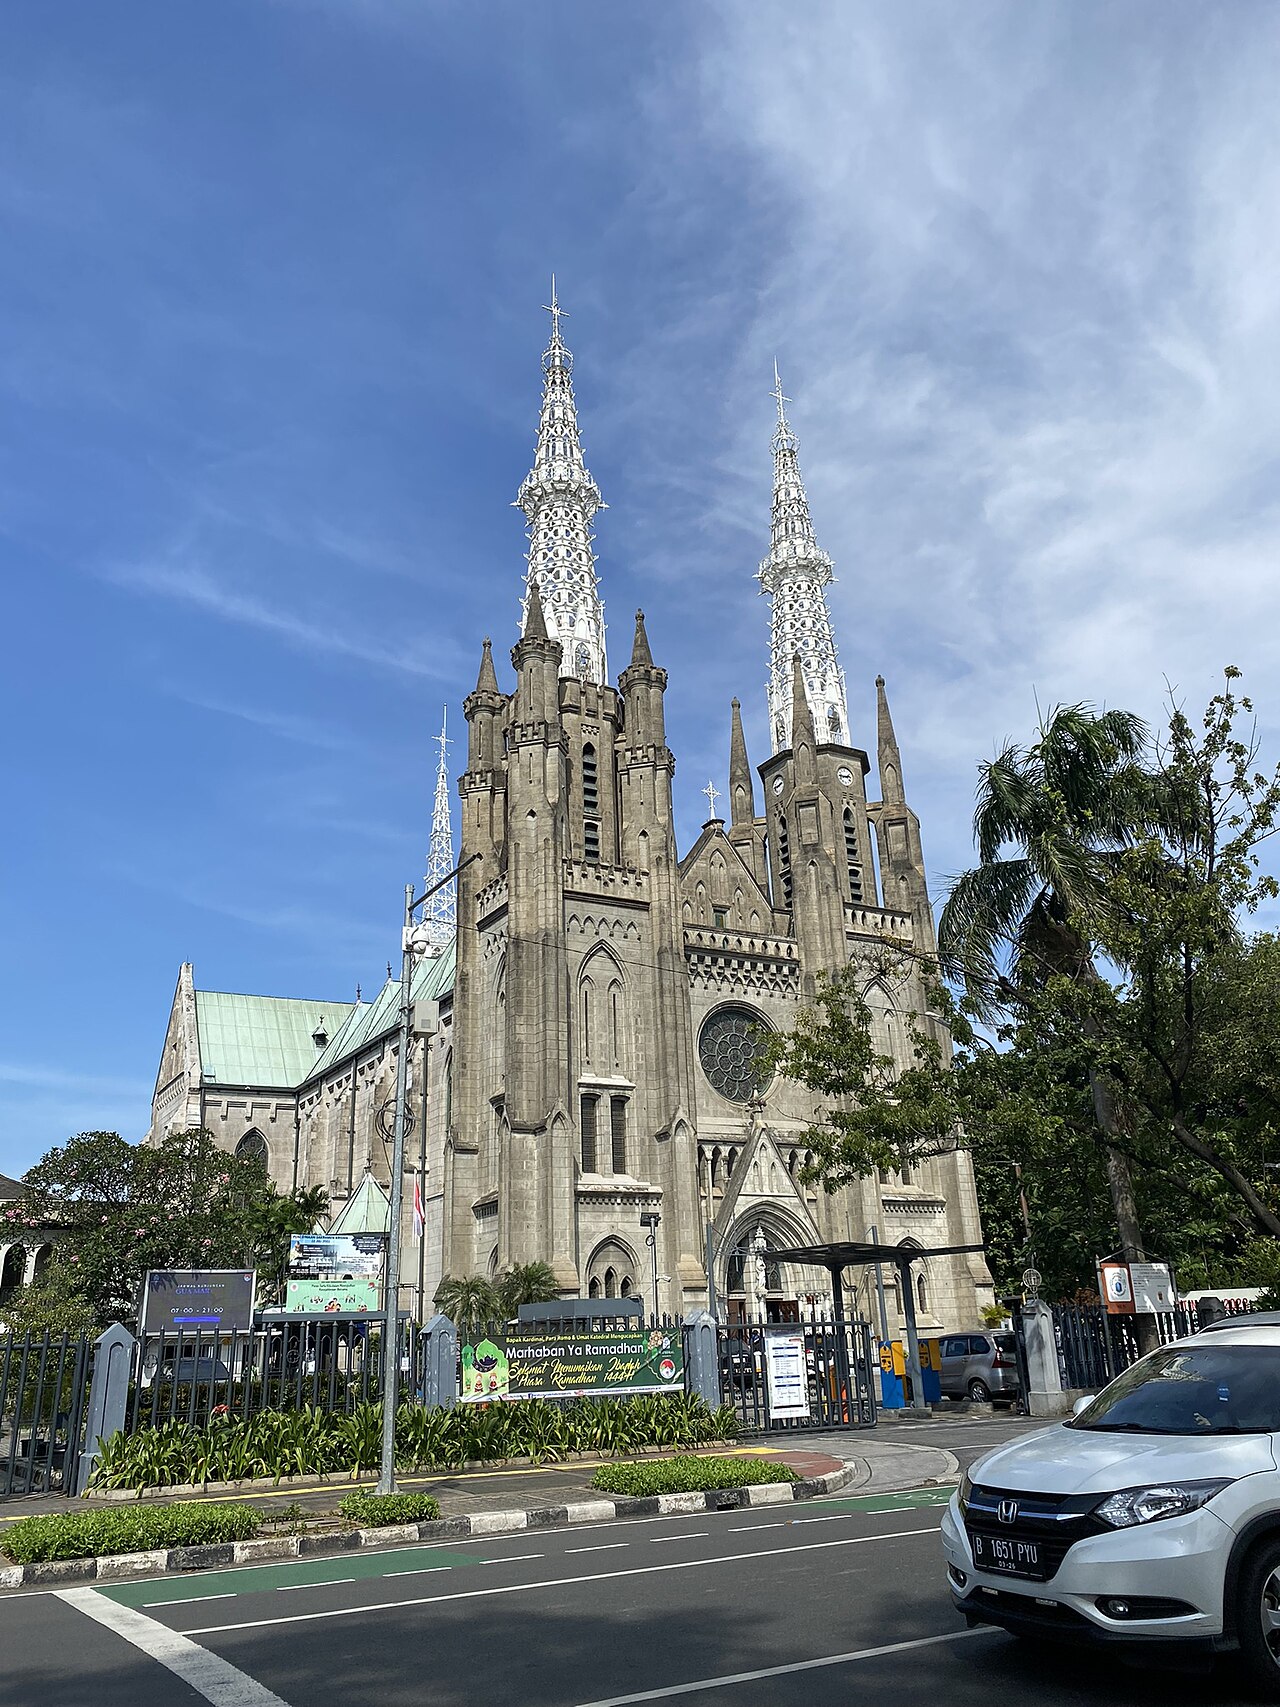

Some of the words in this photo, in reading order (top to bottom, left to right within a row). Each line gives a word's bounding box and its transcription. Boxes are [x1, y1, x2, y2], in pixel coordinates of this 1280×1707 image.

[505, 1346, 565, 1359] Marhaban
[567, 1344, 583, 1356] Ya
[585, 1342, 644, 1355] Ramadhan
[508, 1360, 549, 1379] Selamat
[516, 1374, 545, 1387] Puasa
[550, 1371, 597, 1390] Ramadhan
[976, 1537, 983, 1555] B
[991, 1539, 1014, 1560] 1651
[1017, 1543, 1038, 1564] PYU
